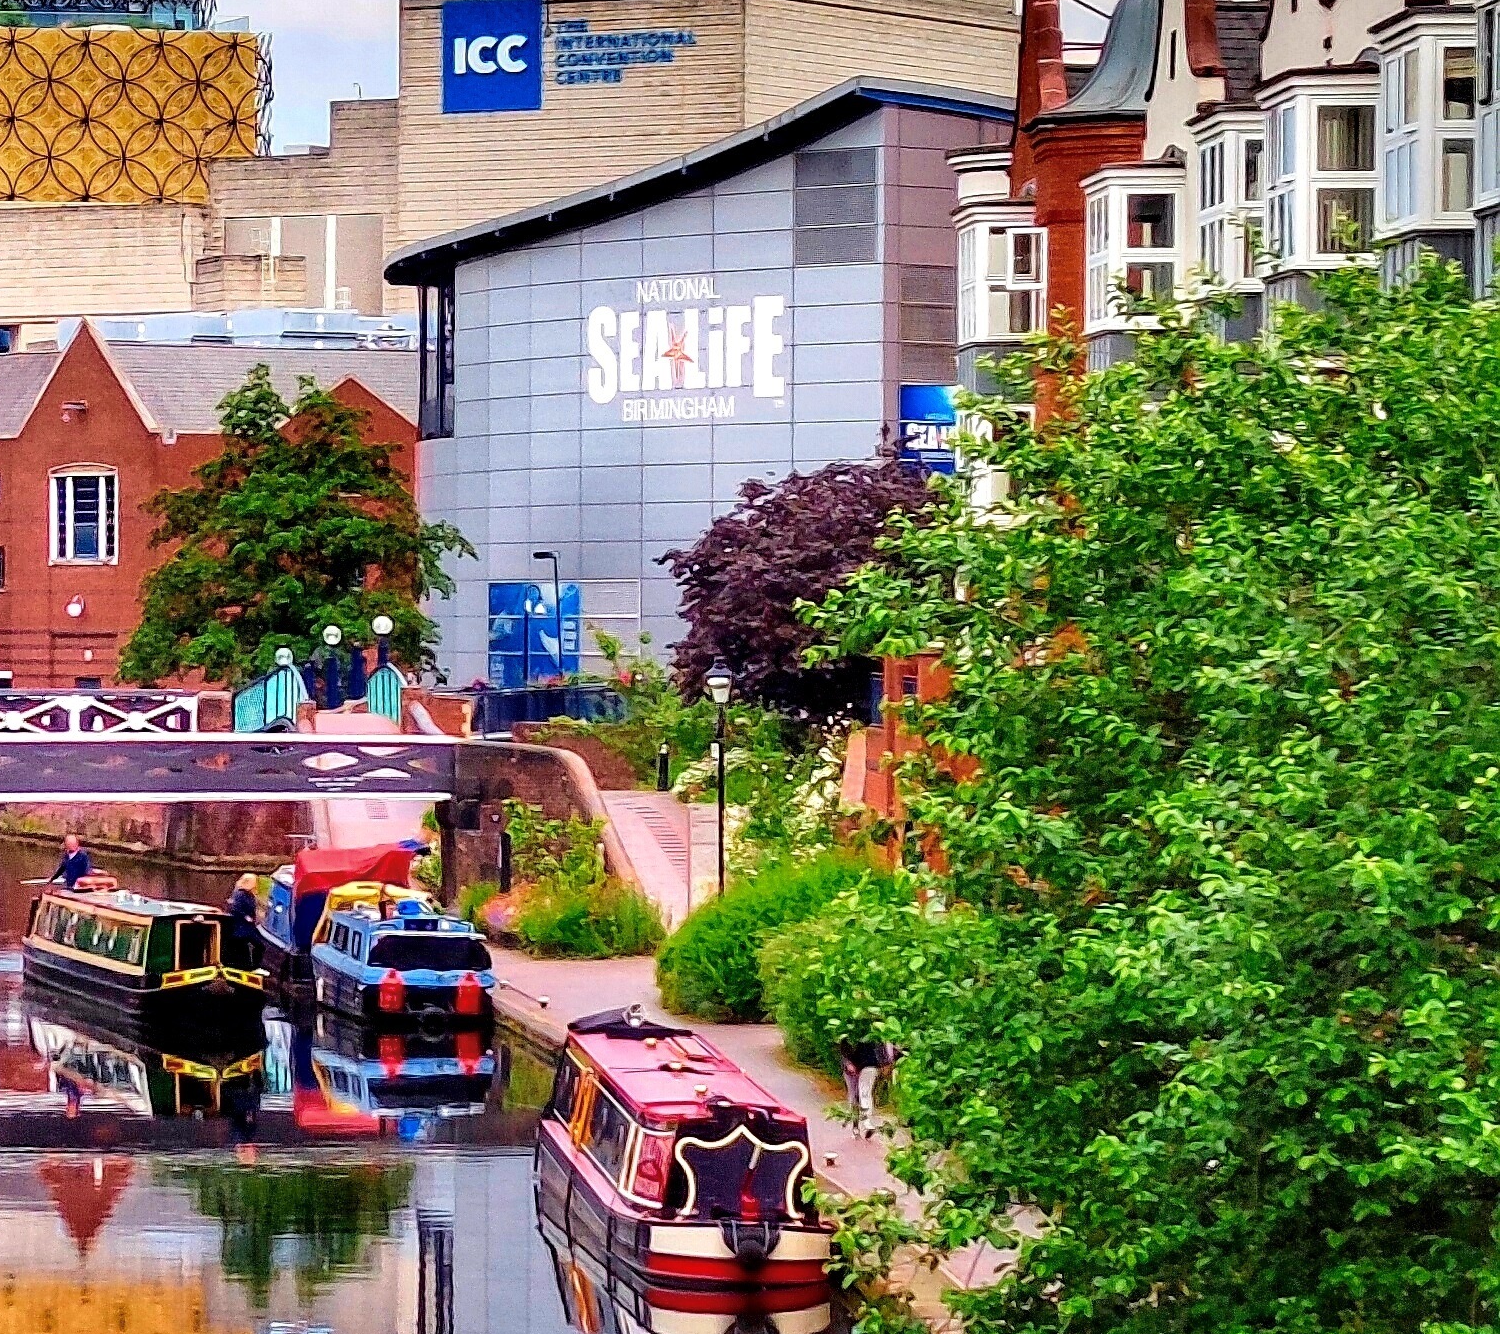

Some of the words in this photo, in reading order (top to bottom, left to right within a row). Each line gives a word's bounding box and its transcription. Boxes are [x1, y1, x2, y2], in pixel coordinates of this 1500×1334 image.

[556, 30, 695, 51] INTERNATIONAL
[453, 34, 528, 75] ICC
[556, 49, 674, 67] CONVENTION
[556, 68, 622, 85] CENTRE
[636, 277, 721, 304] NATIONAL
[587, 305, 672, 405] SEA
[622, 396, 736, 422] BIRMINGHAM
